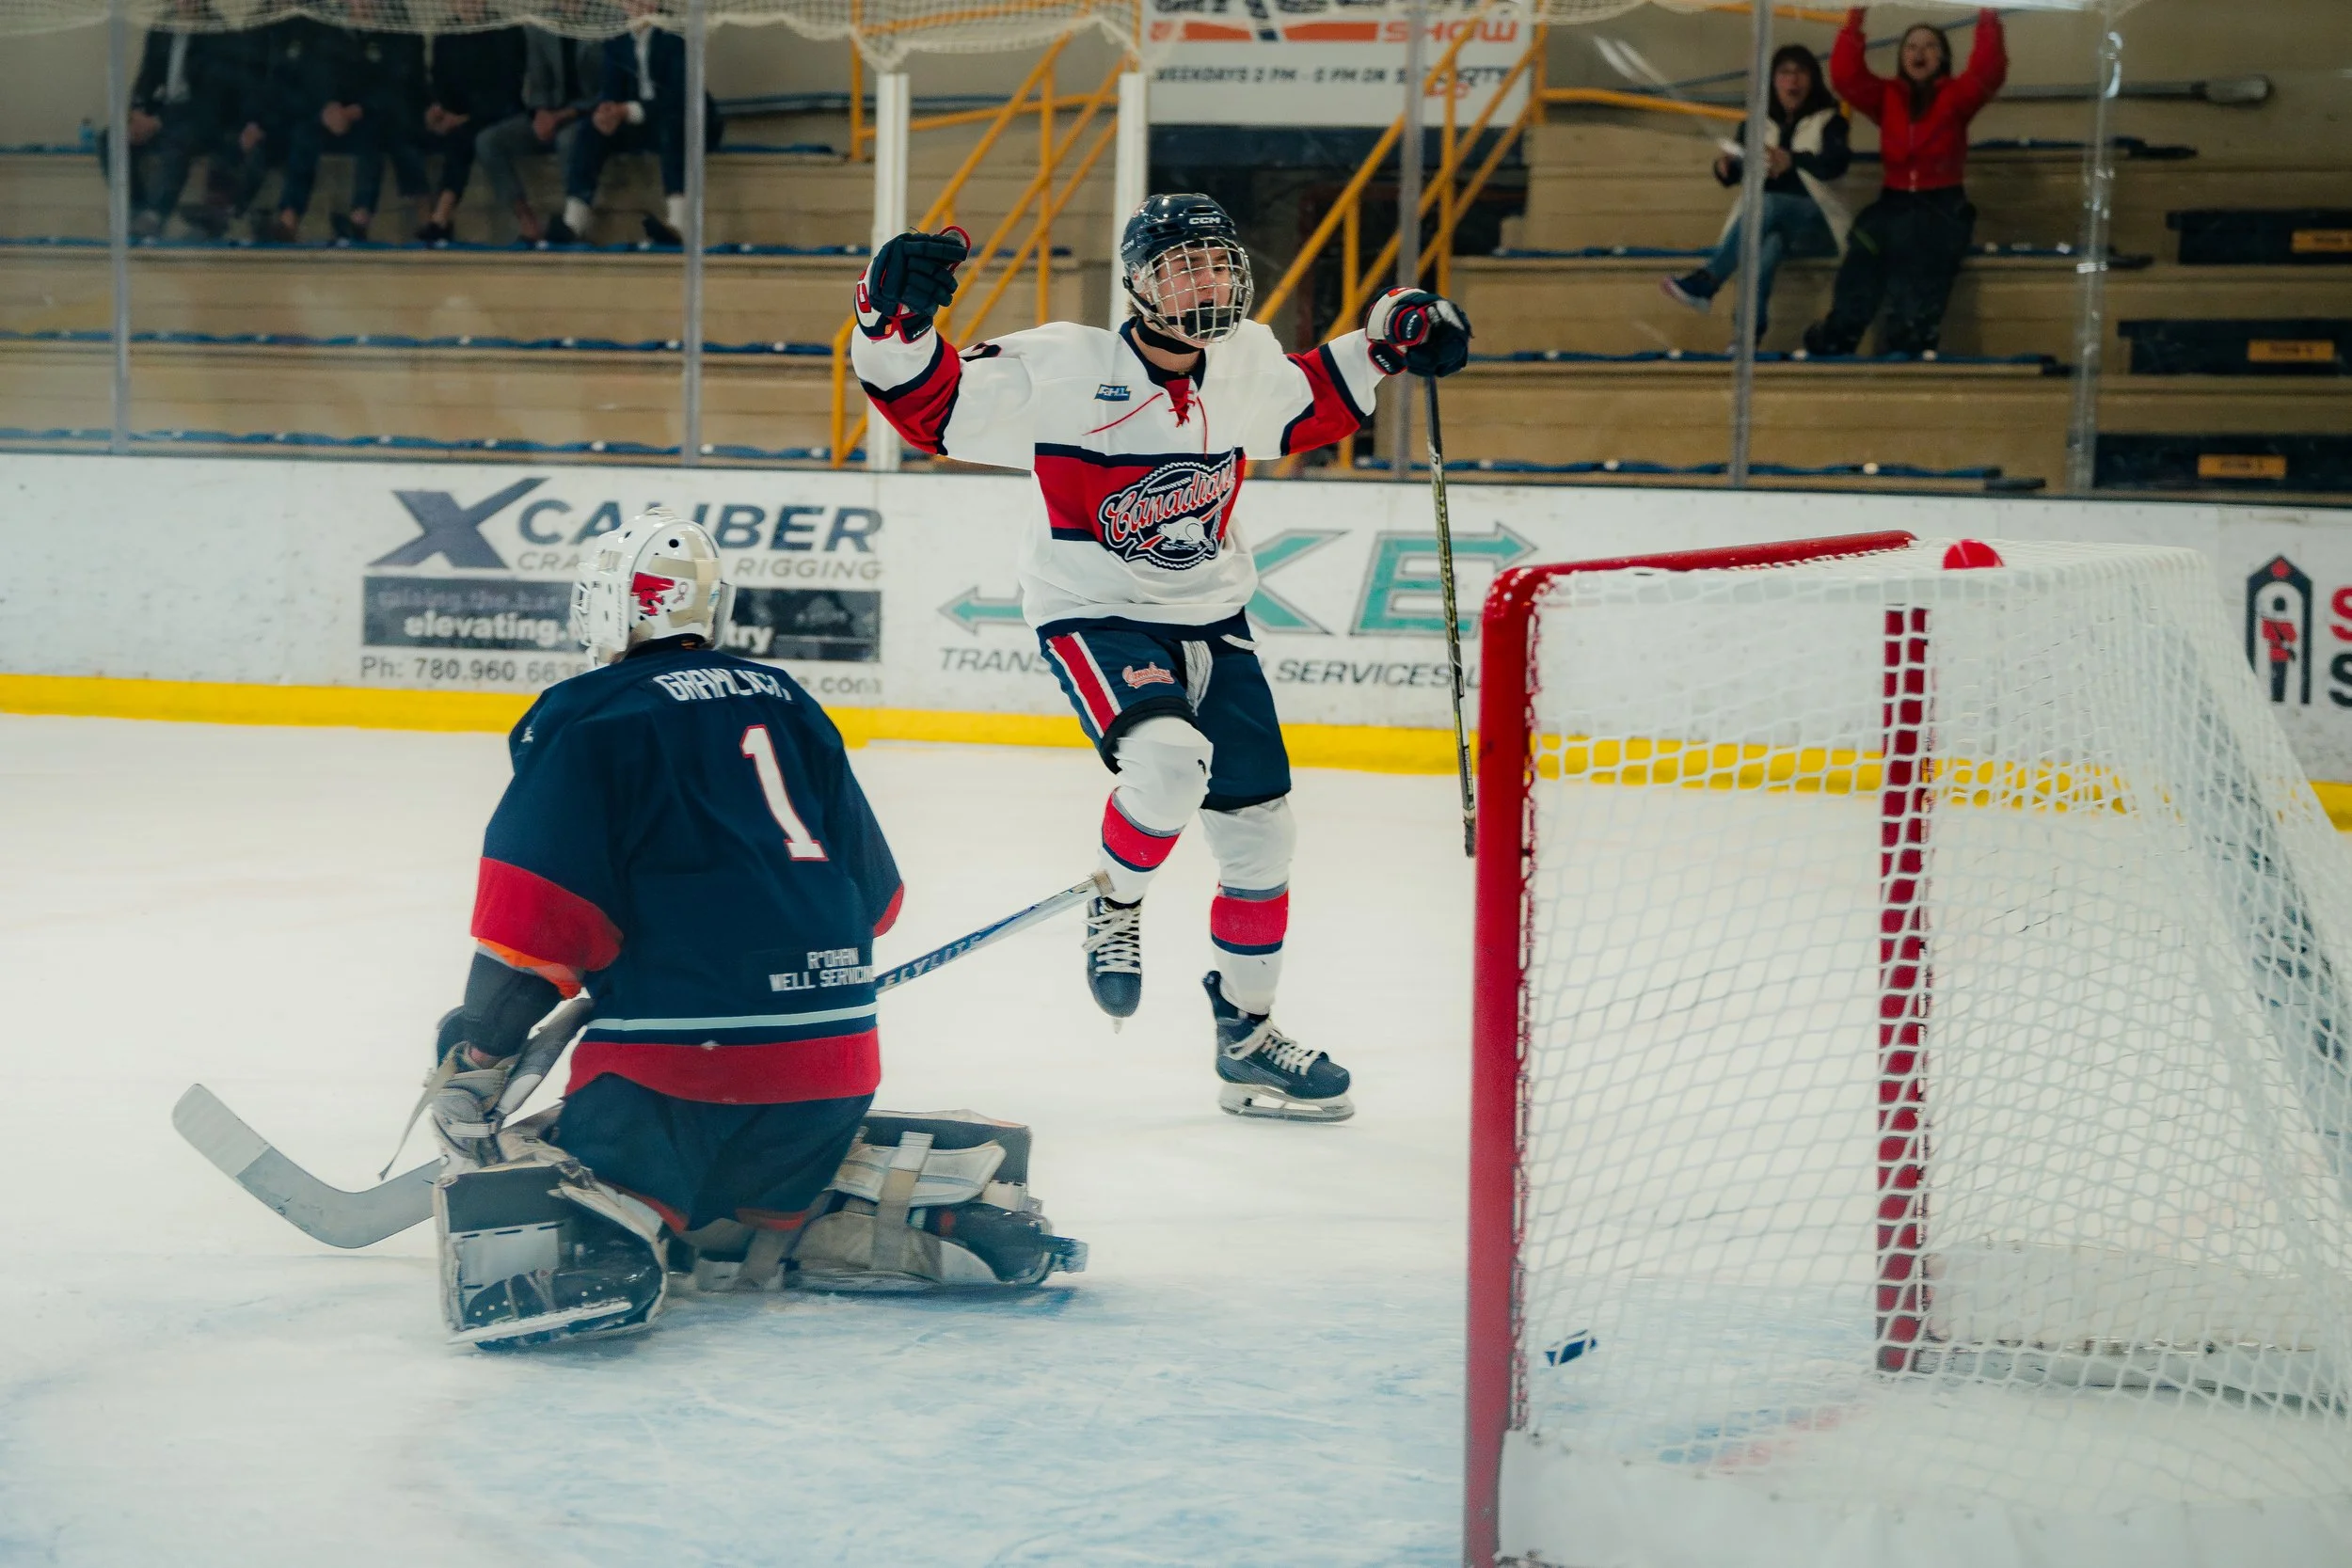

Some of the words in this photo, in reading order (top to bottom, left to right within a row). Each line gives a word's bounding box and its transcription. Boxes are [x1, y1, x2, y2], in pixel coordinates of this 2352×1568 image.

[367, 477, 882, 570] XCABER
[733, 557, 882, 580] RIGGING
[1276, 658, 1451, 688] SERVICES
[739, 723, 829, 861] 1
[769, 972, 816, 991] WELL
